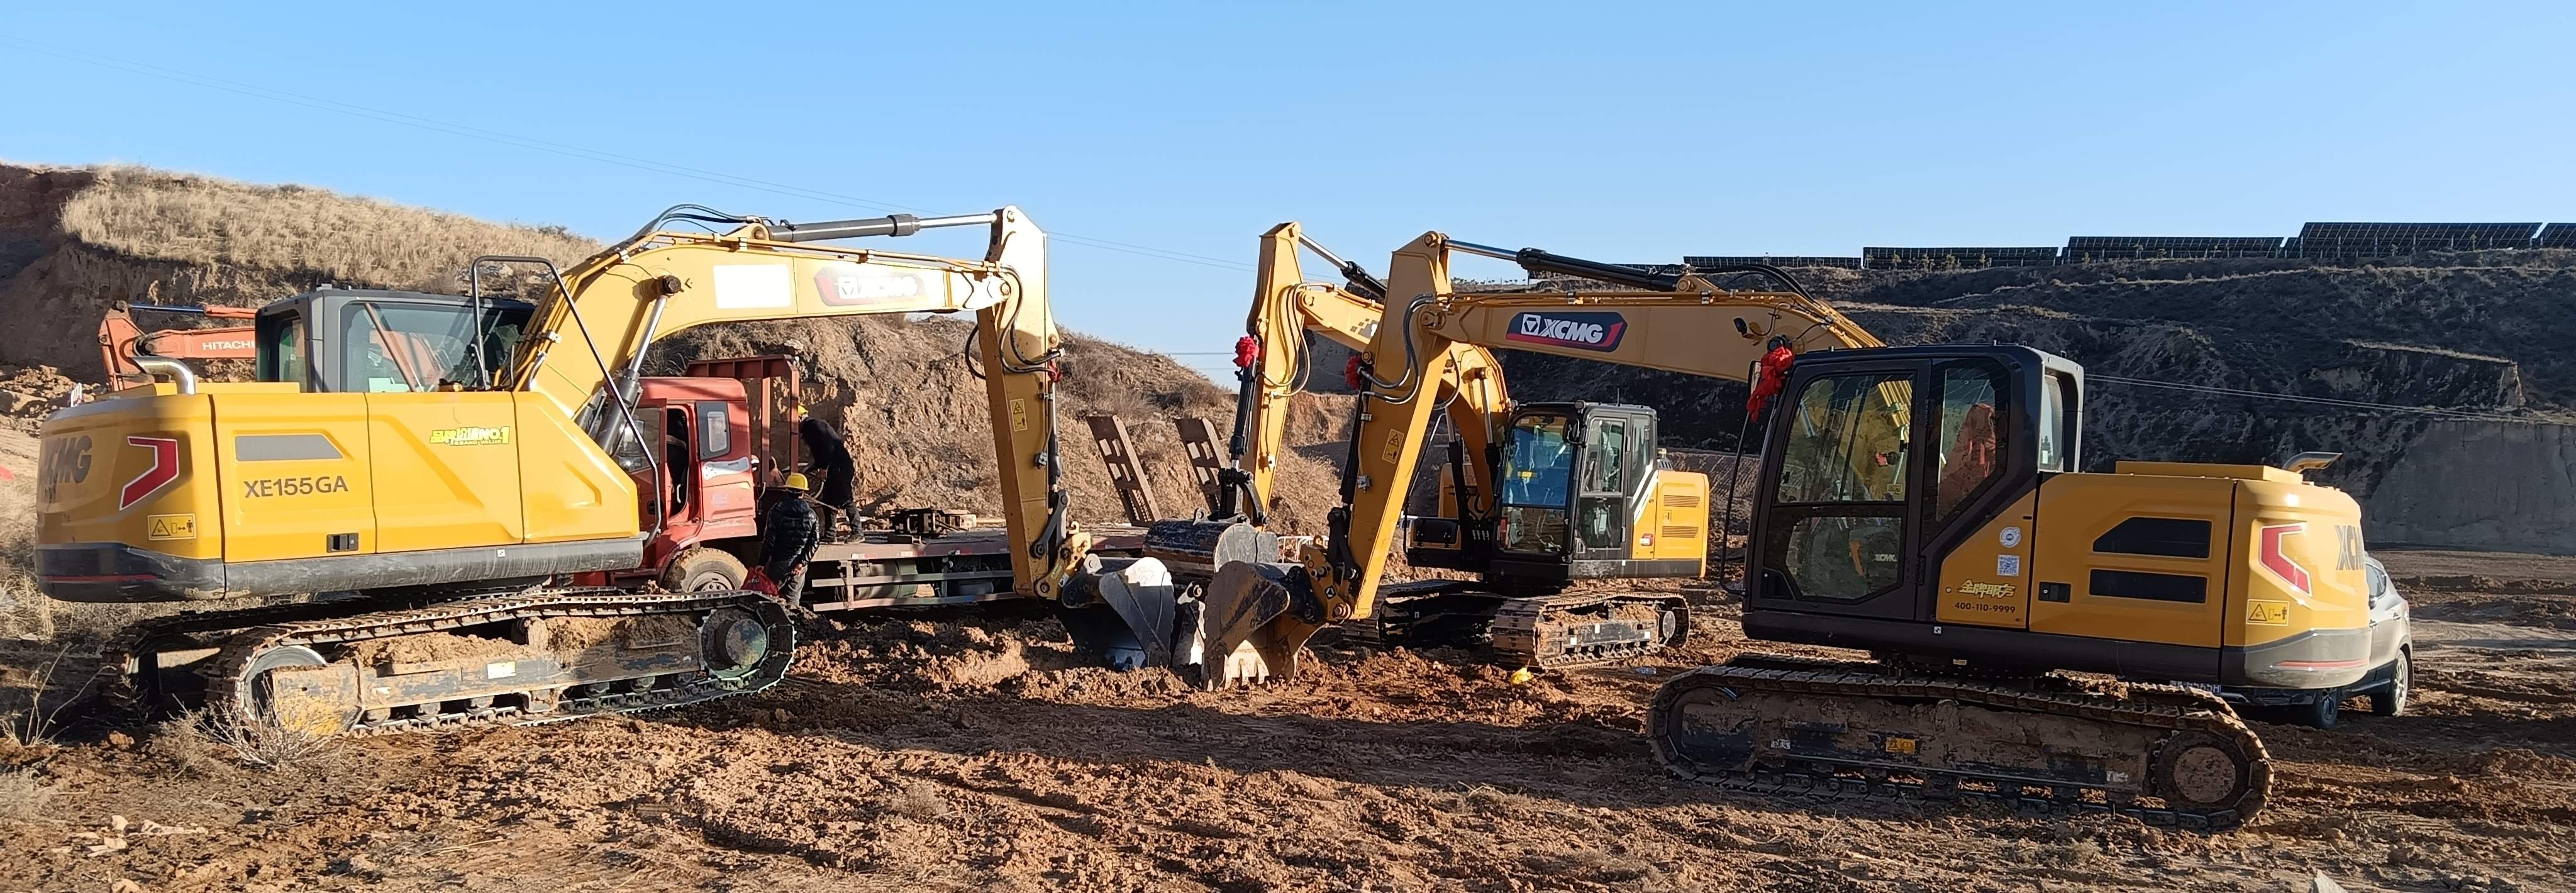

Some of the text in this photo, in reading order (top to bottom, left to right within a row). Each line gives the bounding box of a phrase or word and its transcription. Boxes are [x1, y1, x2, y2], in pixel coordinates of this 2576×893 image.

[1538, 318, 1603, 343] XCMG
[202, 340, 255, 350] HITACHI
[243, 475, 348, 498] XE155GA
[1955, 602, 2016, 613] 400-110-9999
